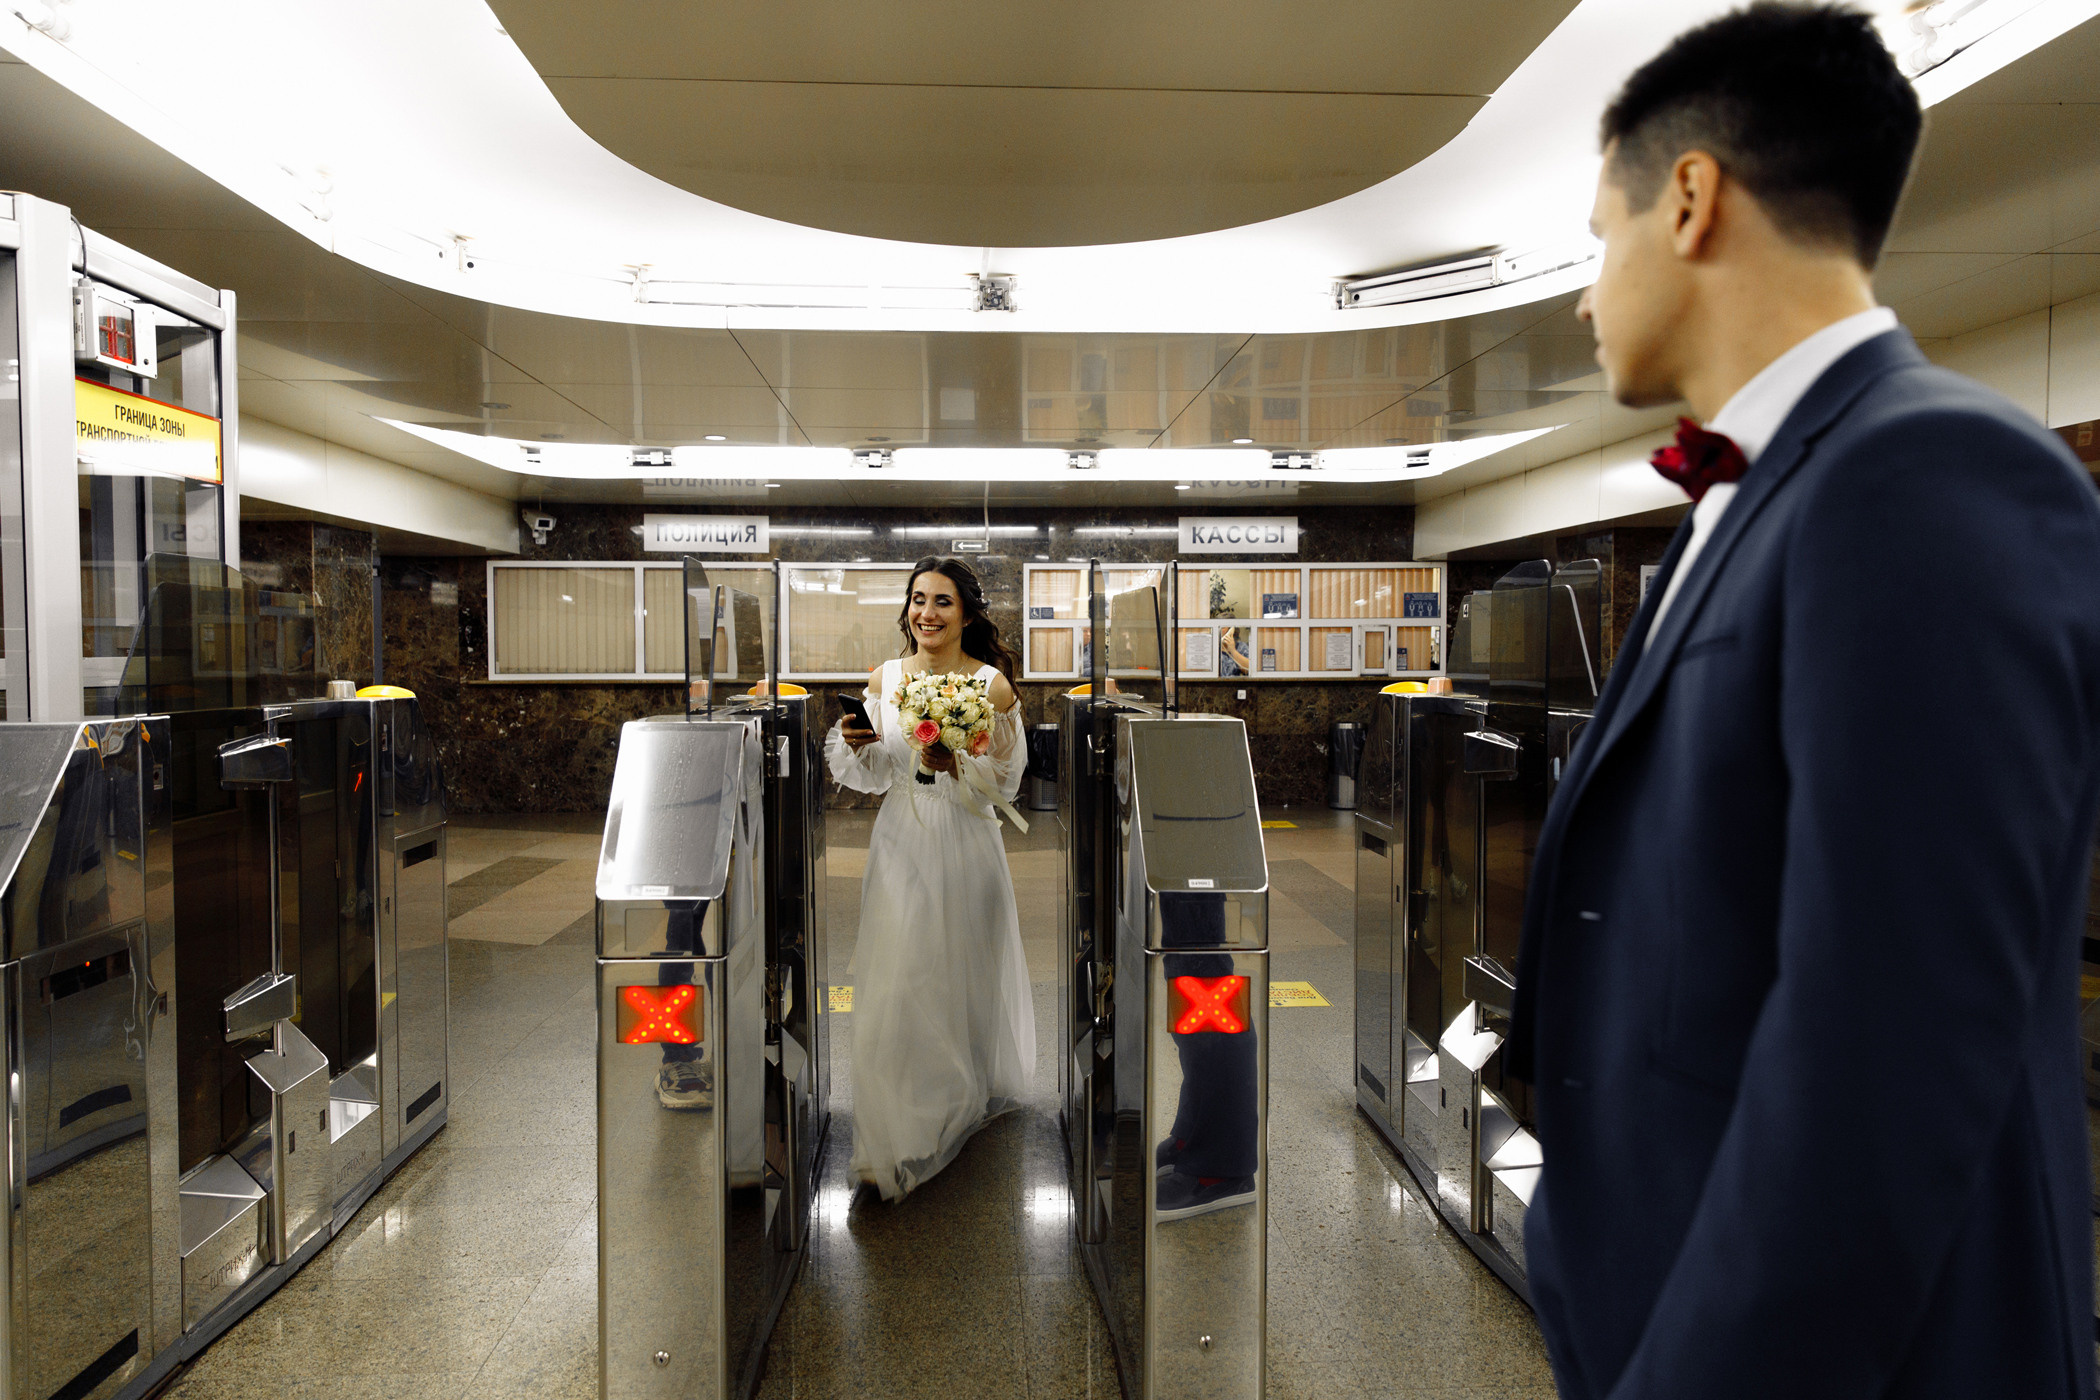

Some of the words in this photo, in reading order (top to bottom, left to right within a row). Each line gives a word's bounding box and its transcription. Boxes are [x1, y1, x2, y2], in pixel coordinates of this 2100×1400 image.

[115, 404, 157, 431] ГРАНИЦА
[160, 417, 185, 437] ЗОНЫ
[656, 523, 757, 546] ПОЛИЦИЯ
[1192, 526, 1285, 544] КАССЫ
